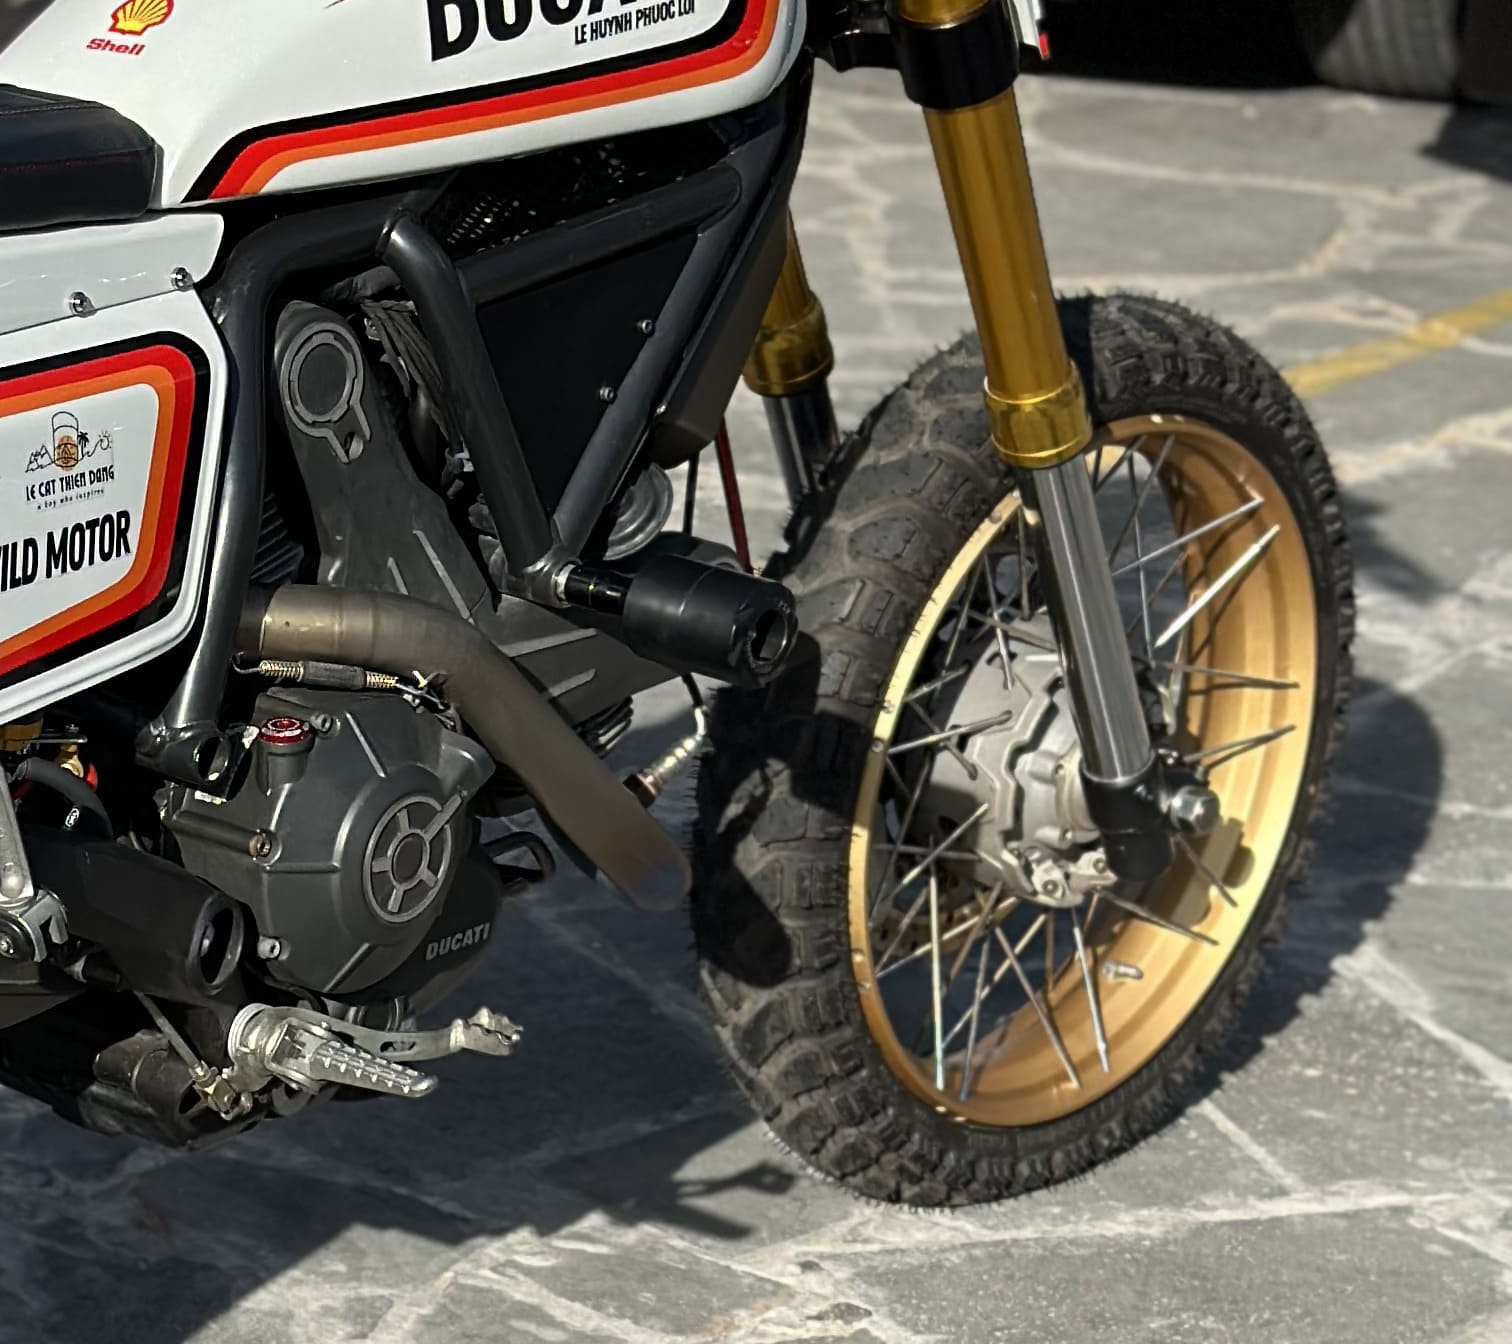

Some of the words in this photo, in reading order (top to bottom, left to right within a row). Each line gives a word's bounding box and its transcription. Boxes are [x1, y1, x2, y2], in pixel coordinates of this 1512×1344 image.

[574, 23, 588, 46] LE
[590, 11, 633, 42] HUYNH
[635, 0, 676, 30] PHUOC
[86, 37, 146, 56] Shell
[25, 484, 37, 502] LE
[38, 478, 57, 498] CAT
[58, 471, 87, 493] THIEN
[45, 509, 132, 581] MOTOR
[425, 922, 491, 961] DUCATI
